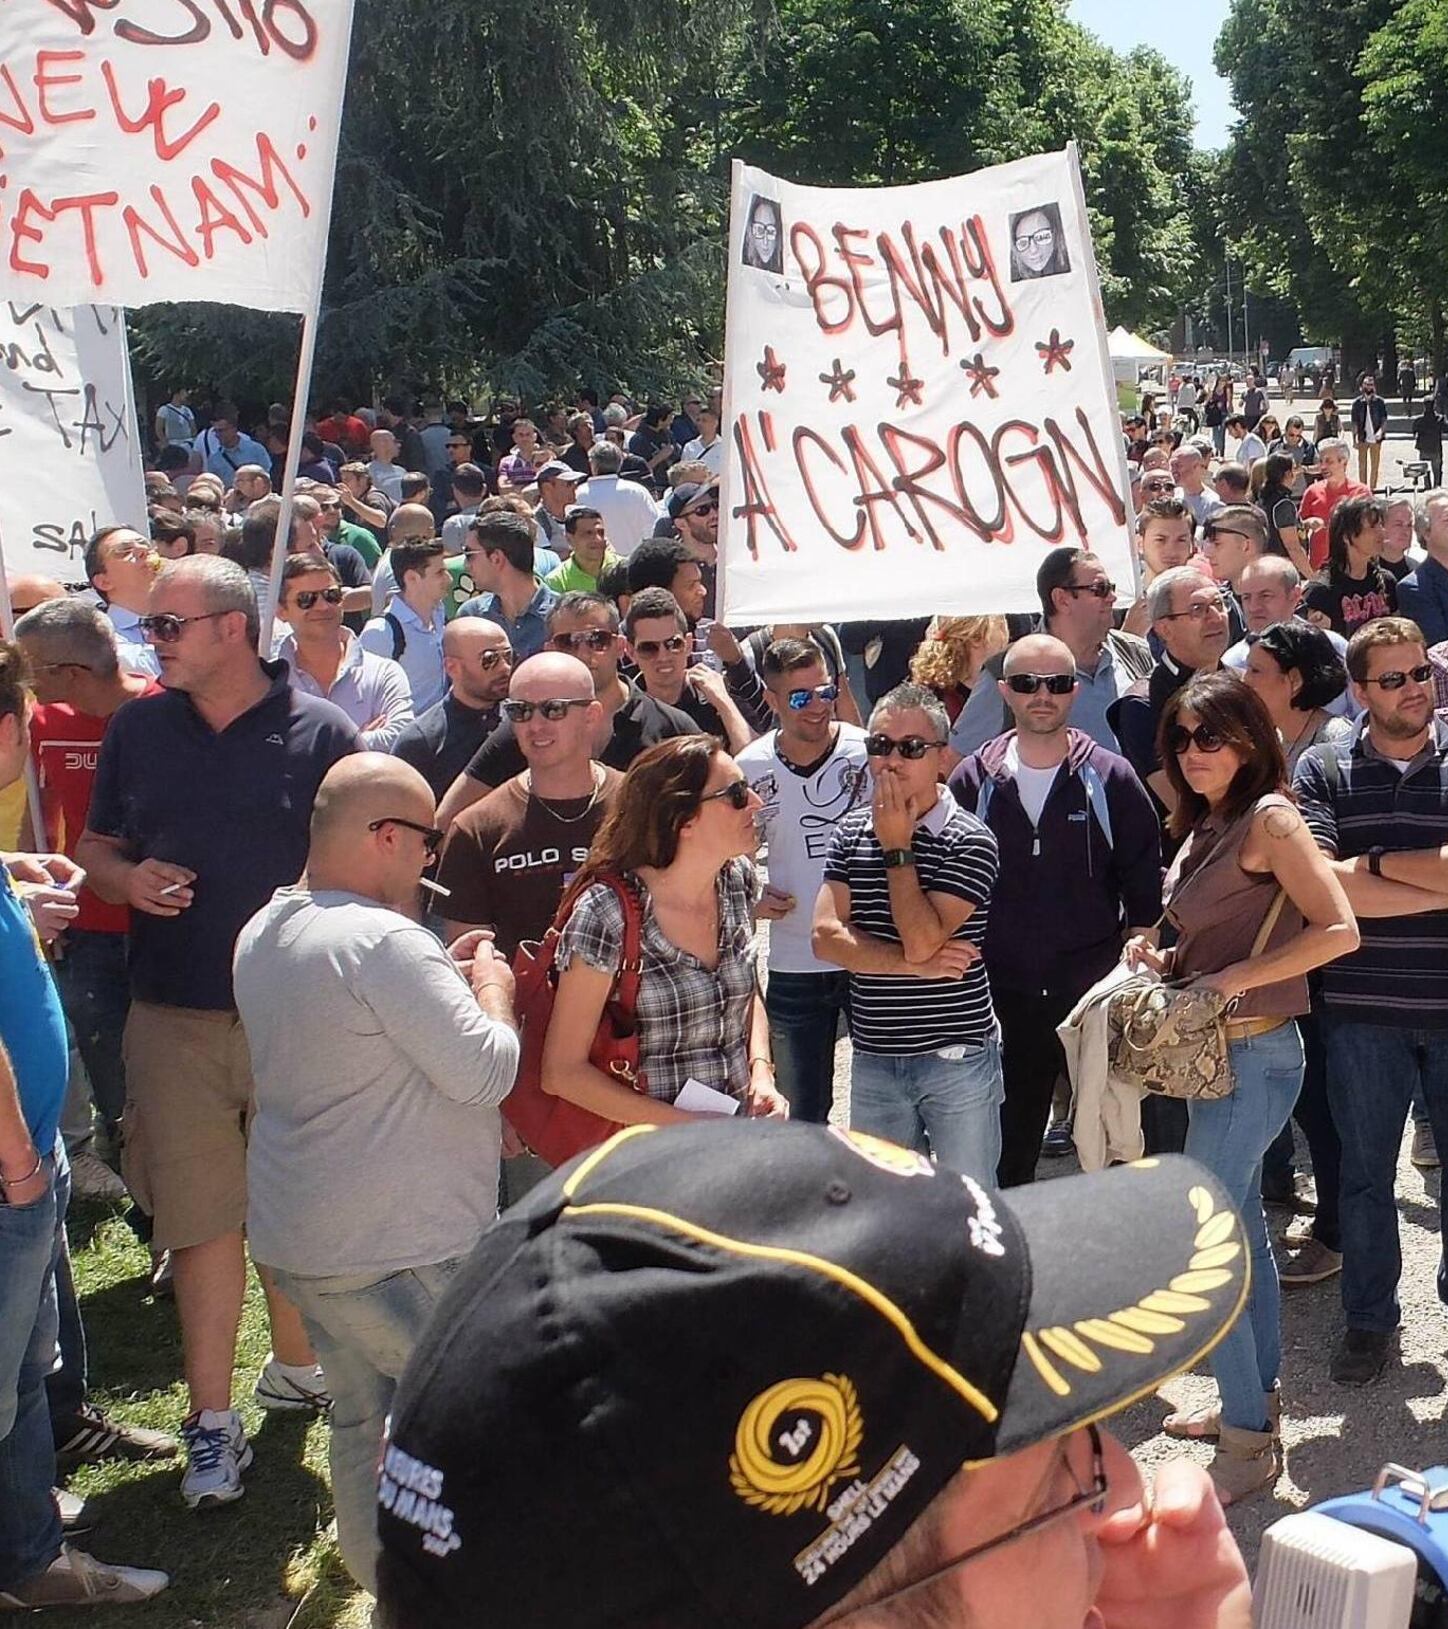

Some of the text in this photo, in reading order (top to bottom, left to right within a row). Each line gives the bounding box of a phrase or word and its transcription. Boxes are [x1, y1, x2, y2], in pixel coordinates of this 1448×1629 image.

[790, 213, 1014, 357] BENNY
[21, 382, 128, 456] TAX
[792, 406, 1127, 551] CAROGN
[64, 751, 98, 770] DU
[494, 847, 560, 873] POLO
[571, 846, 589, 862] S
